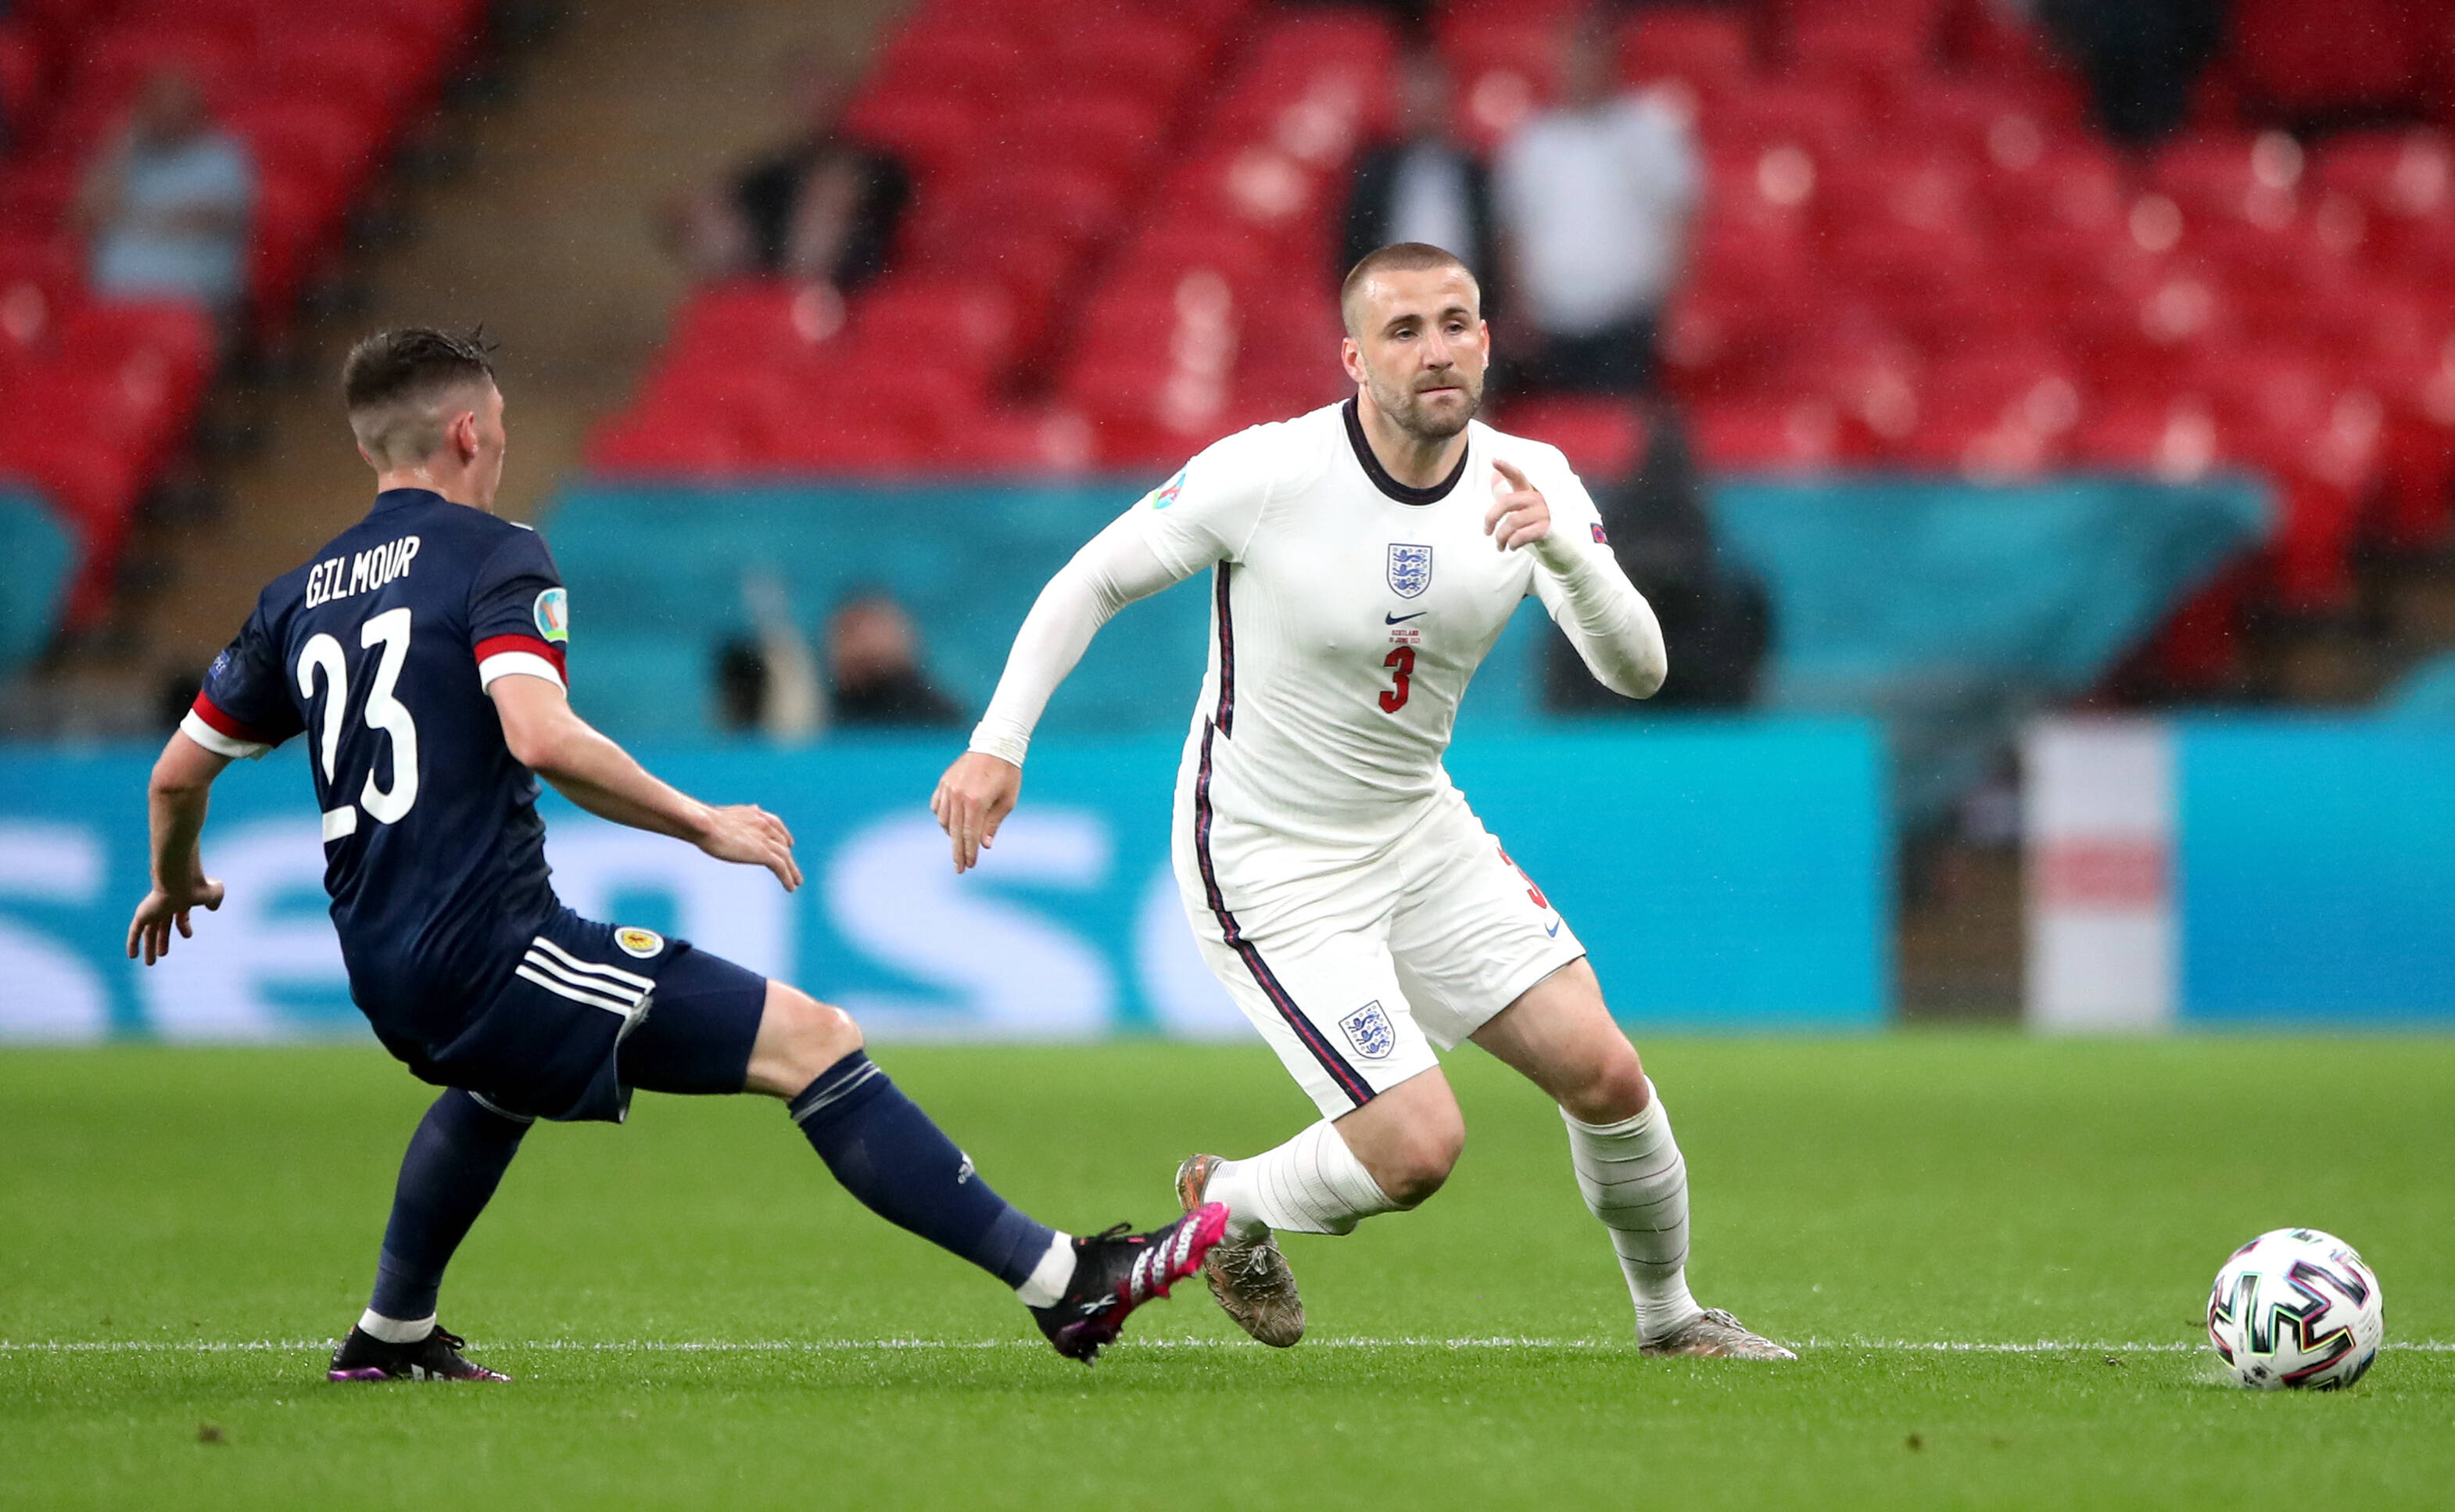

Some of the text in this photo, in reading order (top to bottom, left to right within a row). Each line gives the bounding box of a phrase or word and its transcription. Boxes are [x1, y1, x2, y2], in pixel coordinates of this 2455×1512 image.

[306, 536, 421, 608] GILMOUR
[1378, 646, 1415, 714] 3
[296, 607, 419, 843] 23
